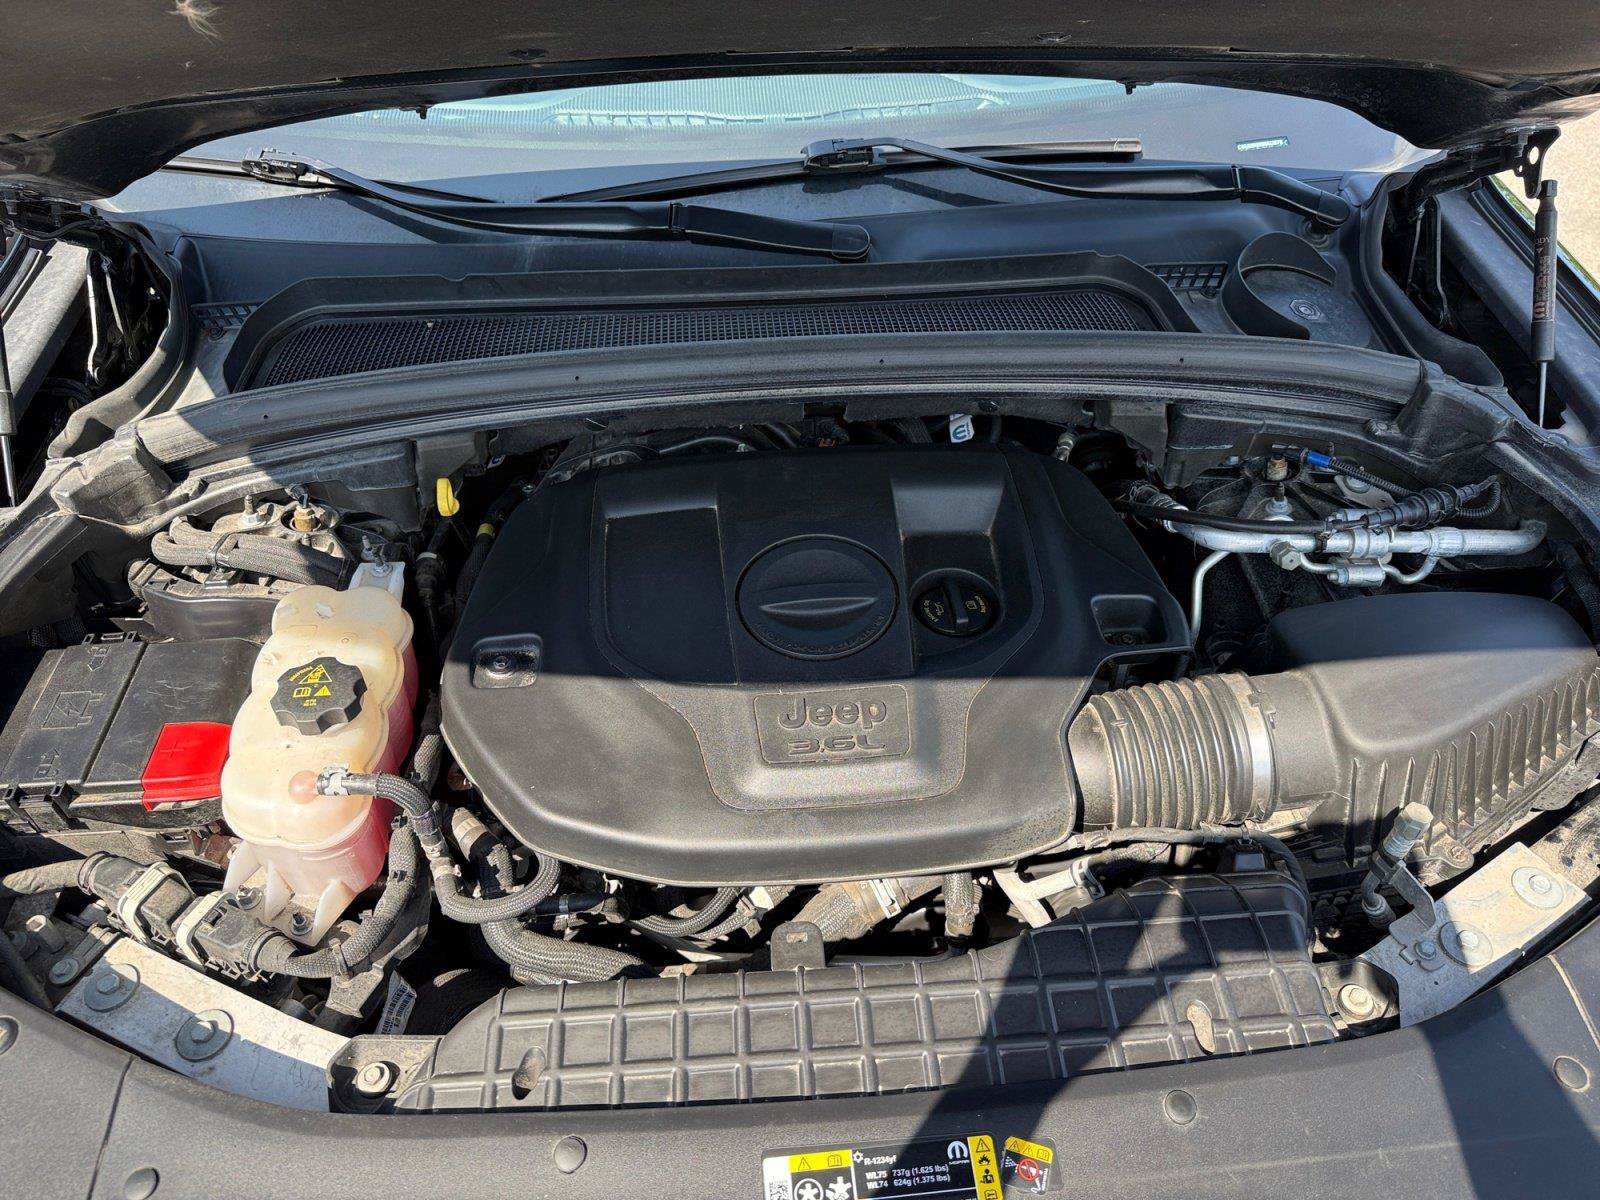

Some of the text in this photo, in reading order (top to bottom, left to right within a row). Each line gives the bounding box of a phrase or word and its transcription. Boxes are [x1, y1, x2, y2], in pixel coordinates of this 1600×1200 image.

[778, 697, 887, 730] Jeep
[788, 734, 886, 756] 3.6L
[864, 1154, 897, 1165] R-1234yf
[865, 1164, 949, 1179] WL75 737g (1.625 lbs)
[866, 1173, 951, 1189] WL74 624g (1.375 lbs)
